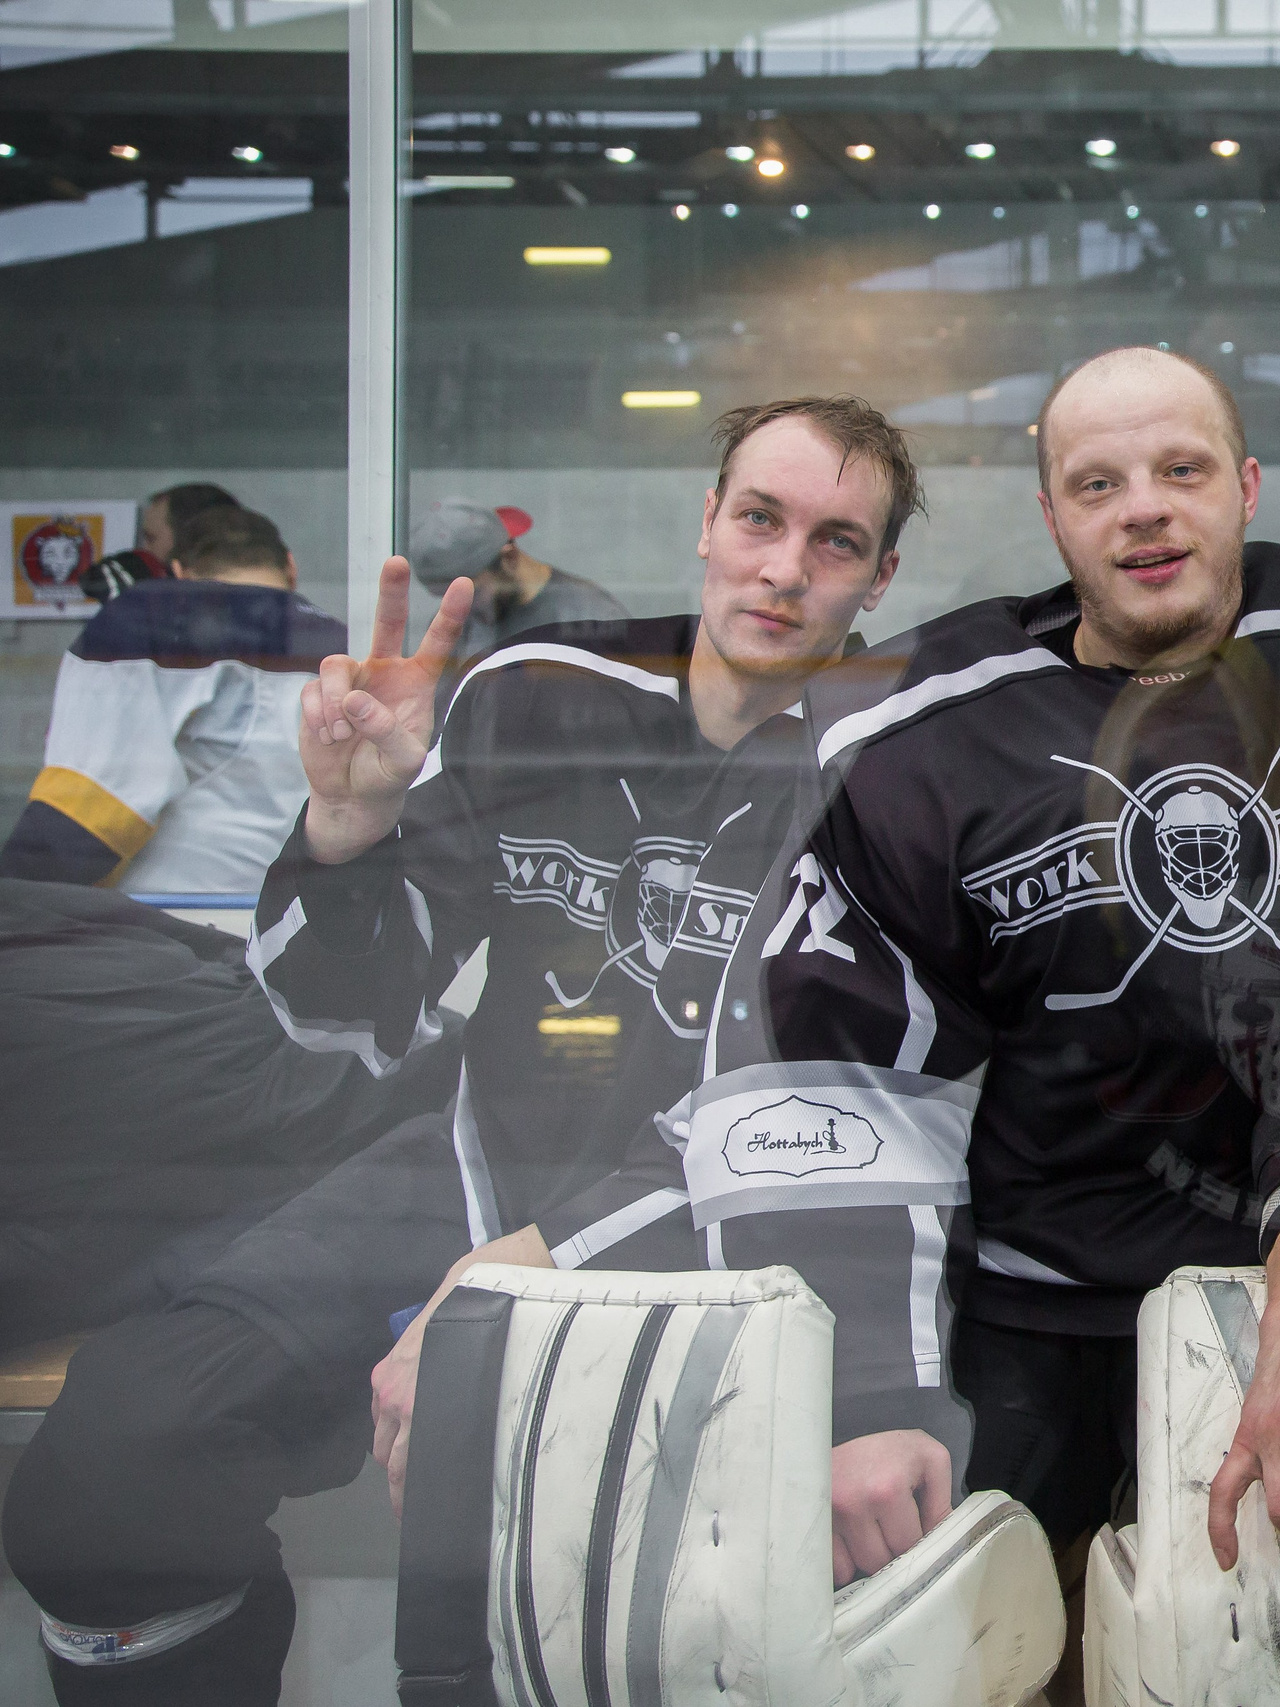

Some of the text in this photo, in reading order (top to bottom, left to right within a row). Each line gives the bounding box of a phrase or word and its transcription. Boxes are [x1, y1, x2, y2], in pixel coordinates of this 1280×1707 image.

[501, 852, 610, 912] Work
[971, 848, 1102, 919] Work
[747, 1131, 823, 1156] Hottabych
